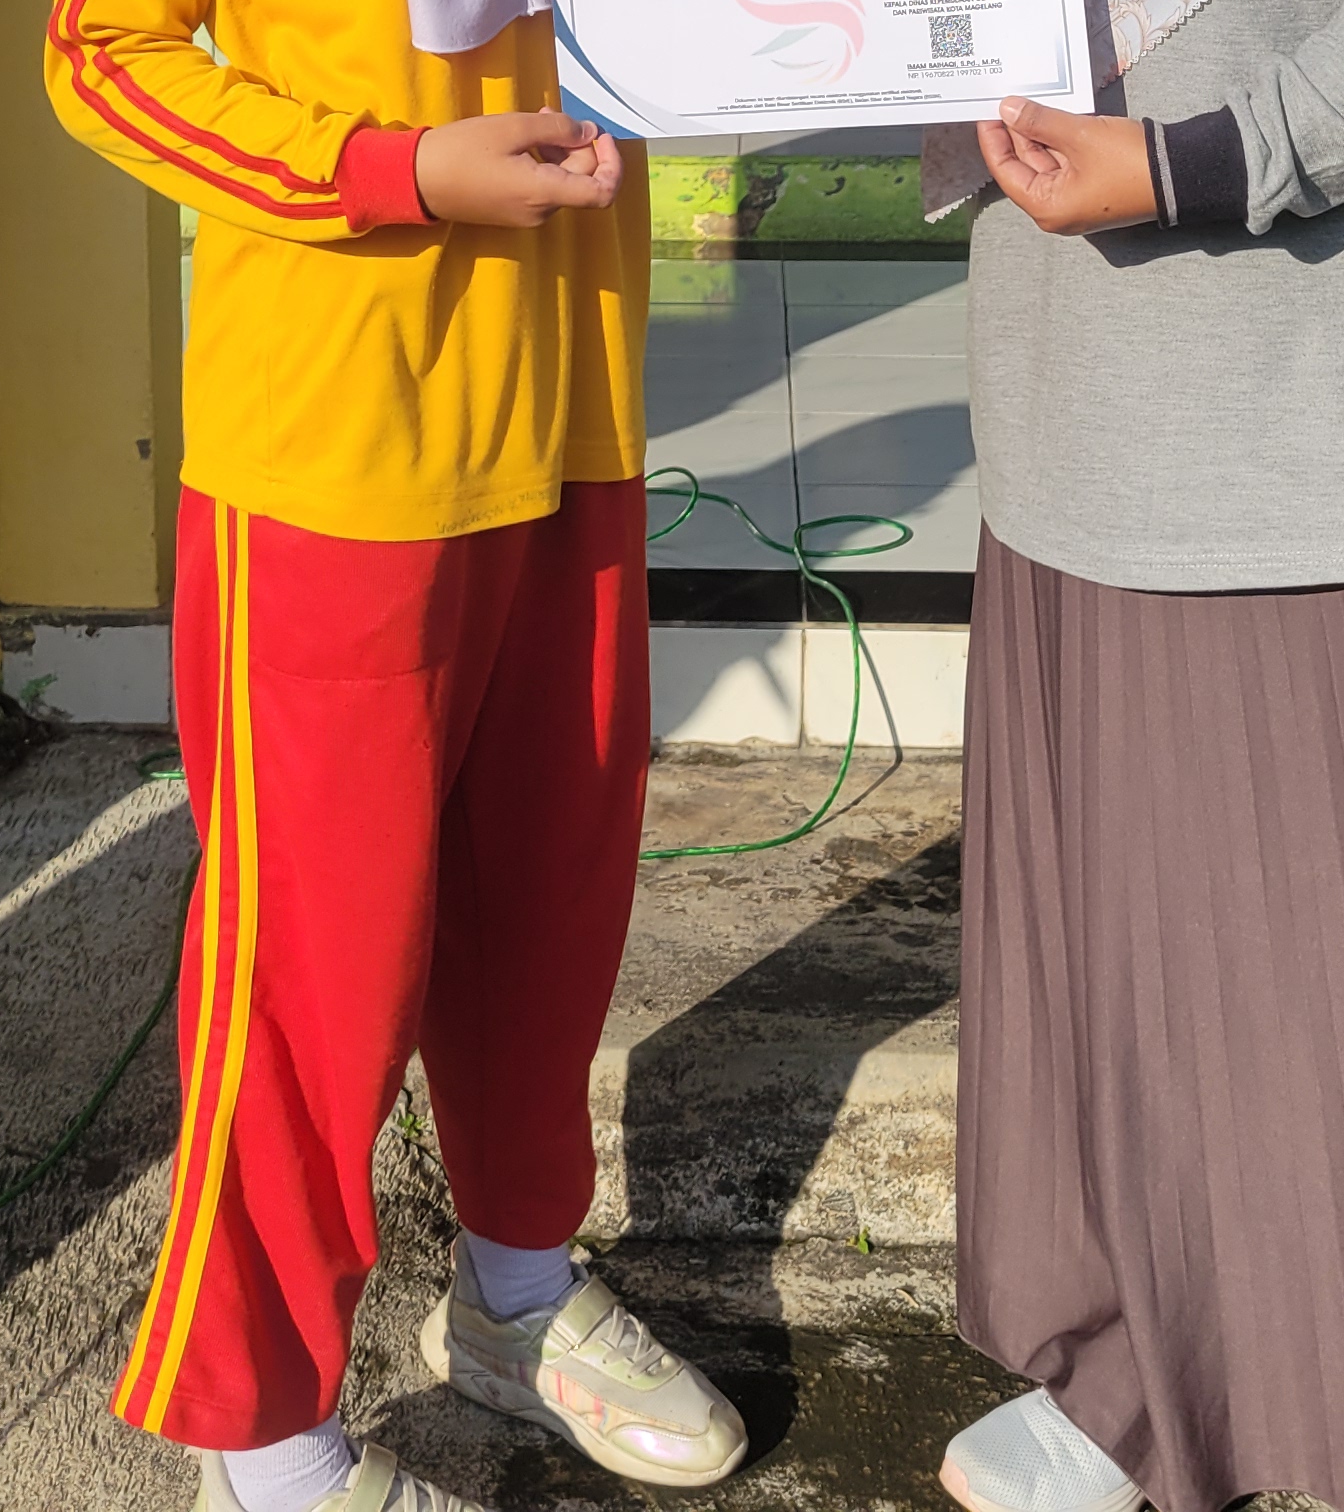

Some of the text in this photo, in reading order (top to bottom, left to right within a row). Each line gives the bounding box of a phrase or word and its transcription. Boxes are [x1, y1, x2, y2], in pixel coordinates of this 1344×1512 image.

[909, 0, 929, 7] DINAS
[964, 2, 1003, 11] MAGELANG
[956, 69, 982, 77] 199702
